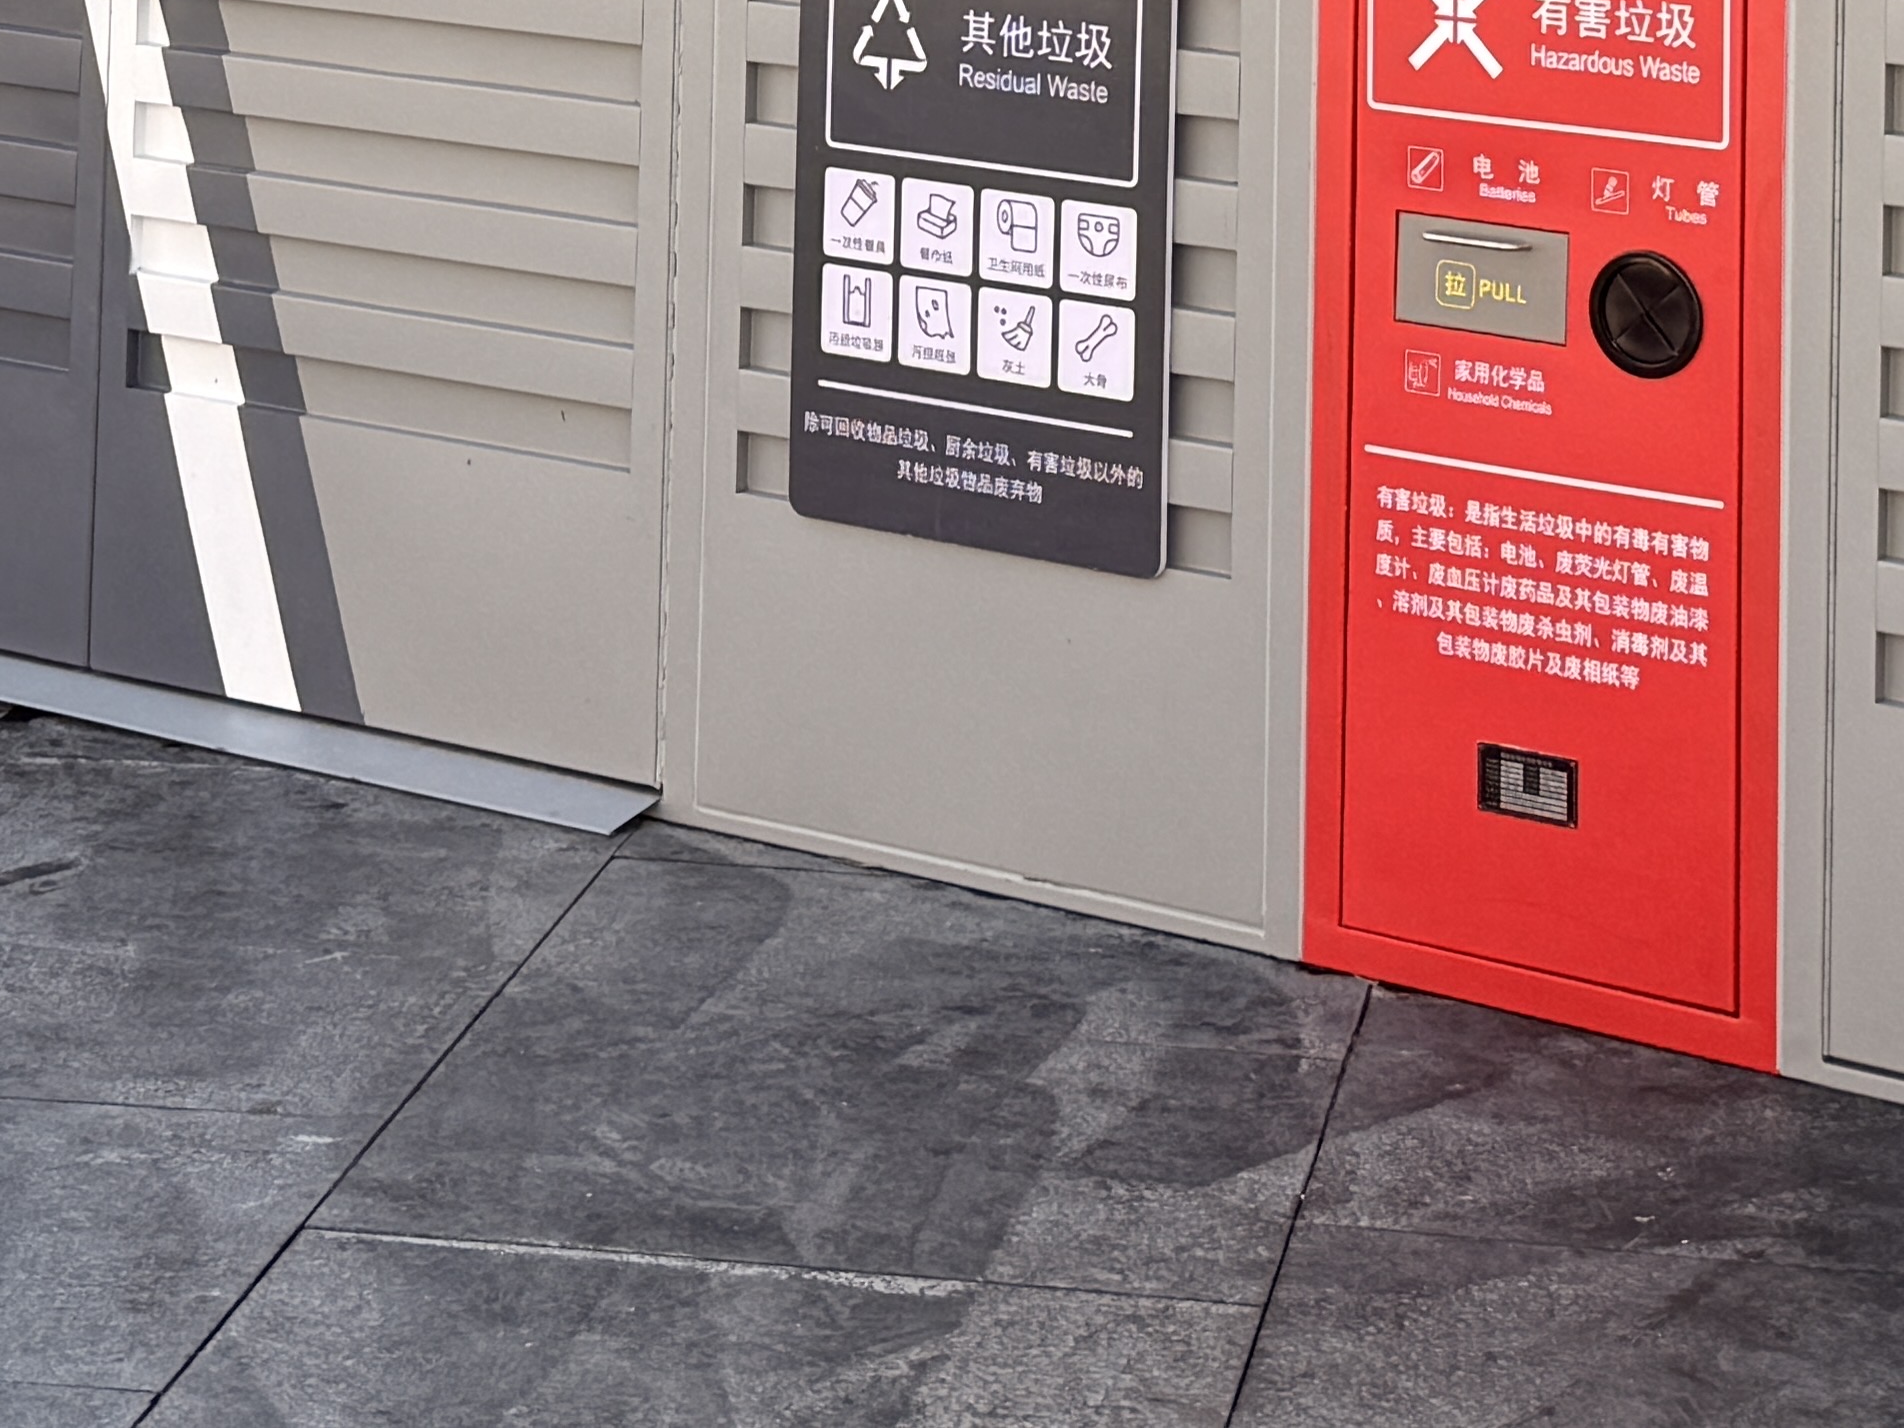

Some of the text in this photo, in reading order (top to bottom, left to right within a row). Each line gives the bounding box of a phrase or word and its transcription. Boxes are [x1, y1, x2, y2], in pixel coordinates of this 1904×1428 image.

[960, 9, 1113, 70] 其他垃圾
[1530, 43, 1700, 84] Hazardous Waste
[959, 64, 1108, 104] Residual Waste
[1472, 153, 1541, 185] 电池
[1479, 182, 1536, 203] Batteries
[1651, 175, 1720, 208] 灯管
[1665, 205, 1708, 225] Tubes
[1445, 271, 1527, 304] 拉 PULL
[1002, 359, 1025, 375] 灰土
[1084, 373, 1107, 389] 大骨
[1454, 359, 1545, 393] 家用化学品
[1447, 386, 1500, 410] Household
[1436, 631, 1641, 691] 包装物废胶片及废相纸等
